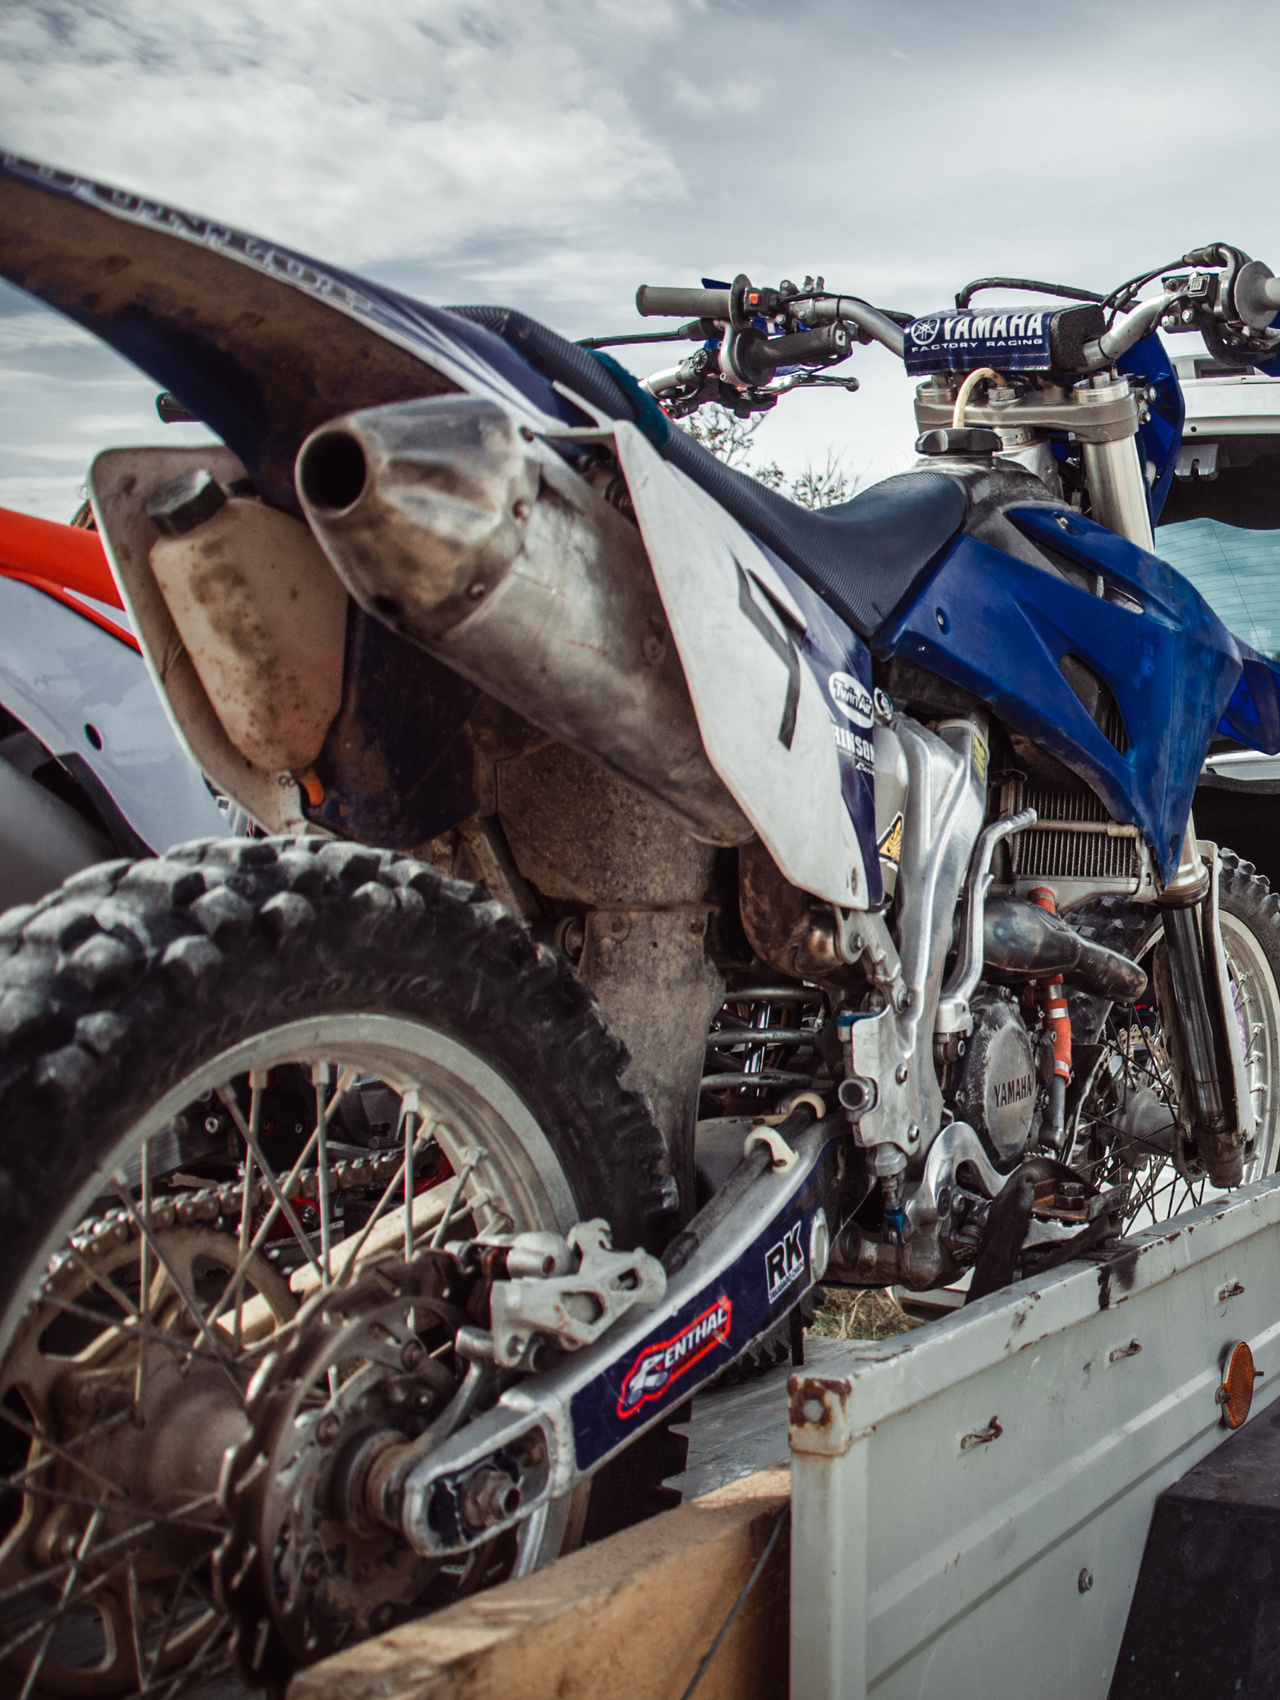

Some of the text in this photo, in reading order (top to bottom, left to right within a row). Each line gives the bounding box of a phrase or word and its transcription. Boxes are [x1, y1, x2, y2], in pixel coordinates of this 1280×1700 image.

[943, 312, 1043, 341] YAMAHA
[911, 338, 1043, 353] FACTORY RACING
[994, 1074, 1032, 1108] YAMAHA
[766, 1224, 803, 1291] RK
